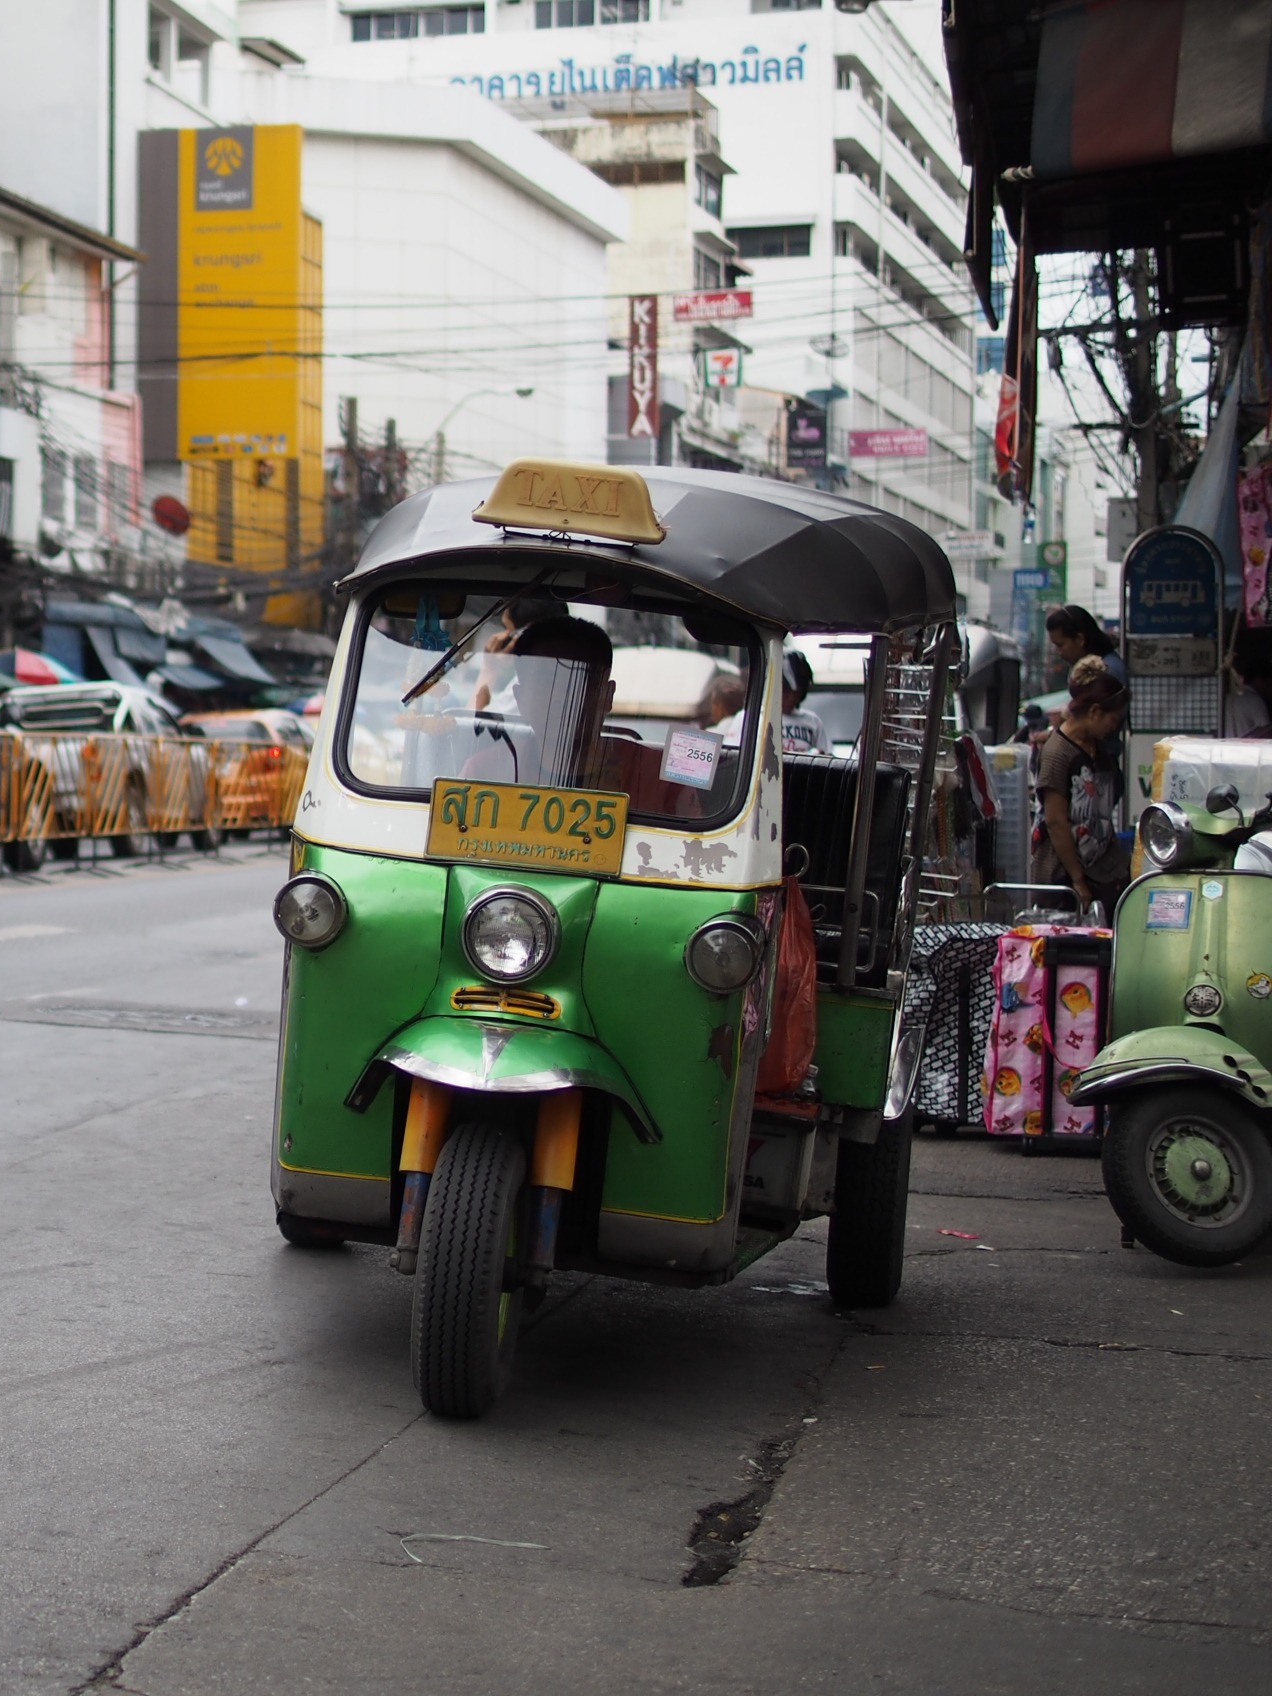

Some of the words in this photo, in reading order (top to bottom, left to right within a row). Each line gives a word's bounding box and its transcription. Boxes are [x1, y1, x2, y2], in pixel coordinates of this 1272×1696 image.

[199, 188, 246, 202] krungsri
[513, 467, 624, 518] TAXI
[687, 748, 713, 763] 2556
[441, 785, 500, 829] สก
[518, 793, 618, 840] 7025
[457, 837, 591, 863] กรุงเทพมหานคร
[1164, 902, 1185, 911] 2556
